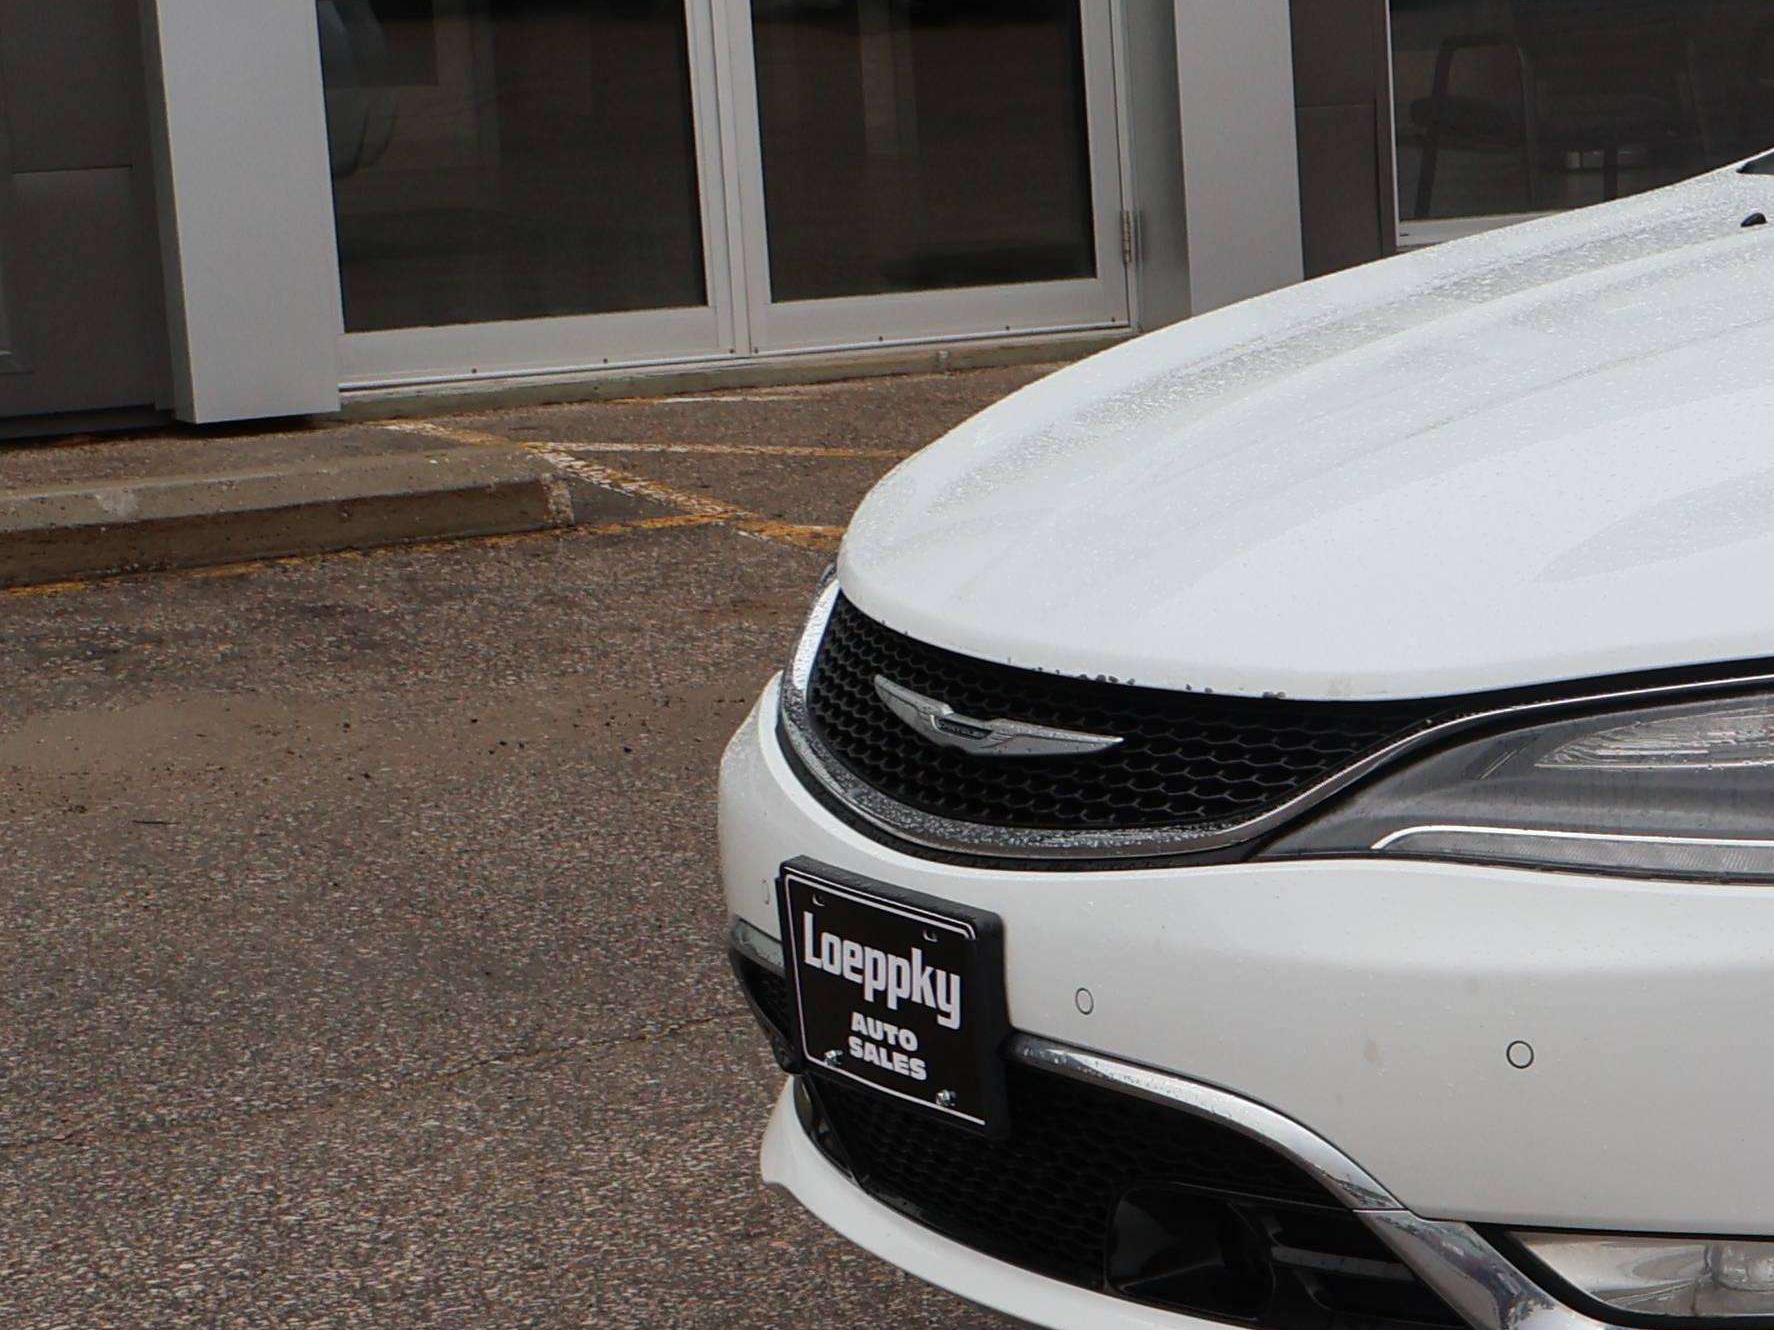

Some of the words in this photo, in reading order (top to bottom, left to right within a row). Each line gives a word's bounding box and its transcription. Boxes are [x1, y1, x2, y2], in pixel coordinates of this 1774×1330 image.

[804, 910, 961, 1031] Loeppky
[851, 1011, 919, 1053] AUTO
[848, 1035, 928, 1082] SALES
